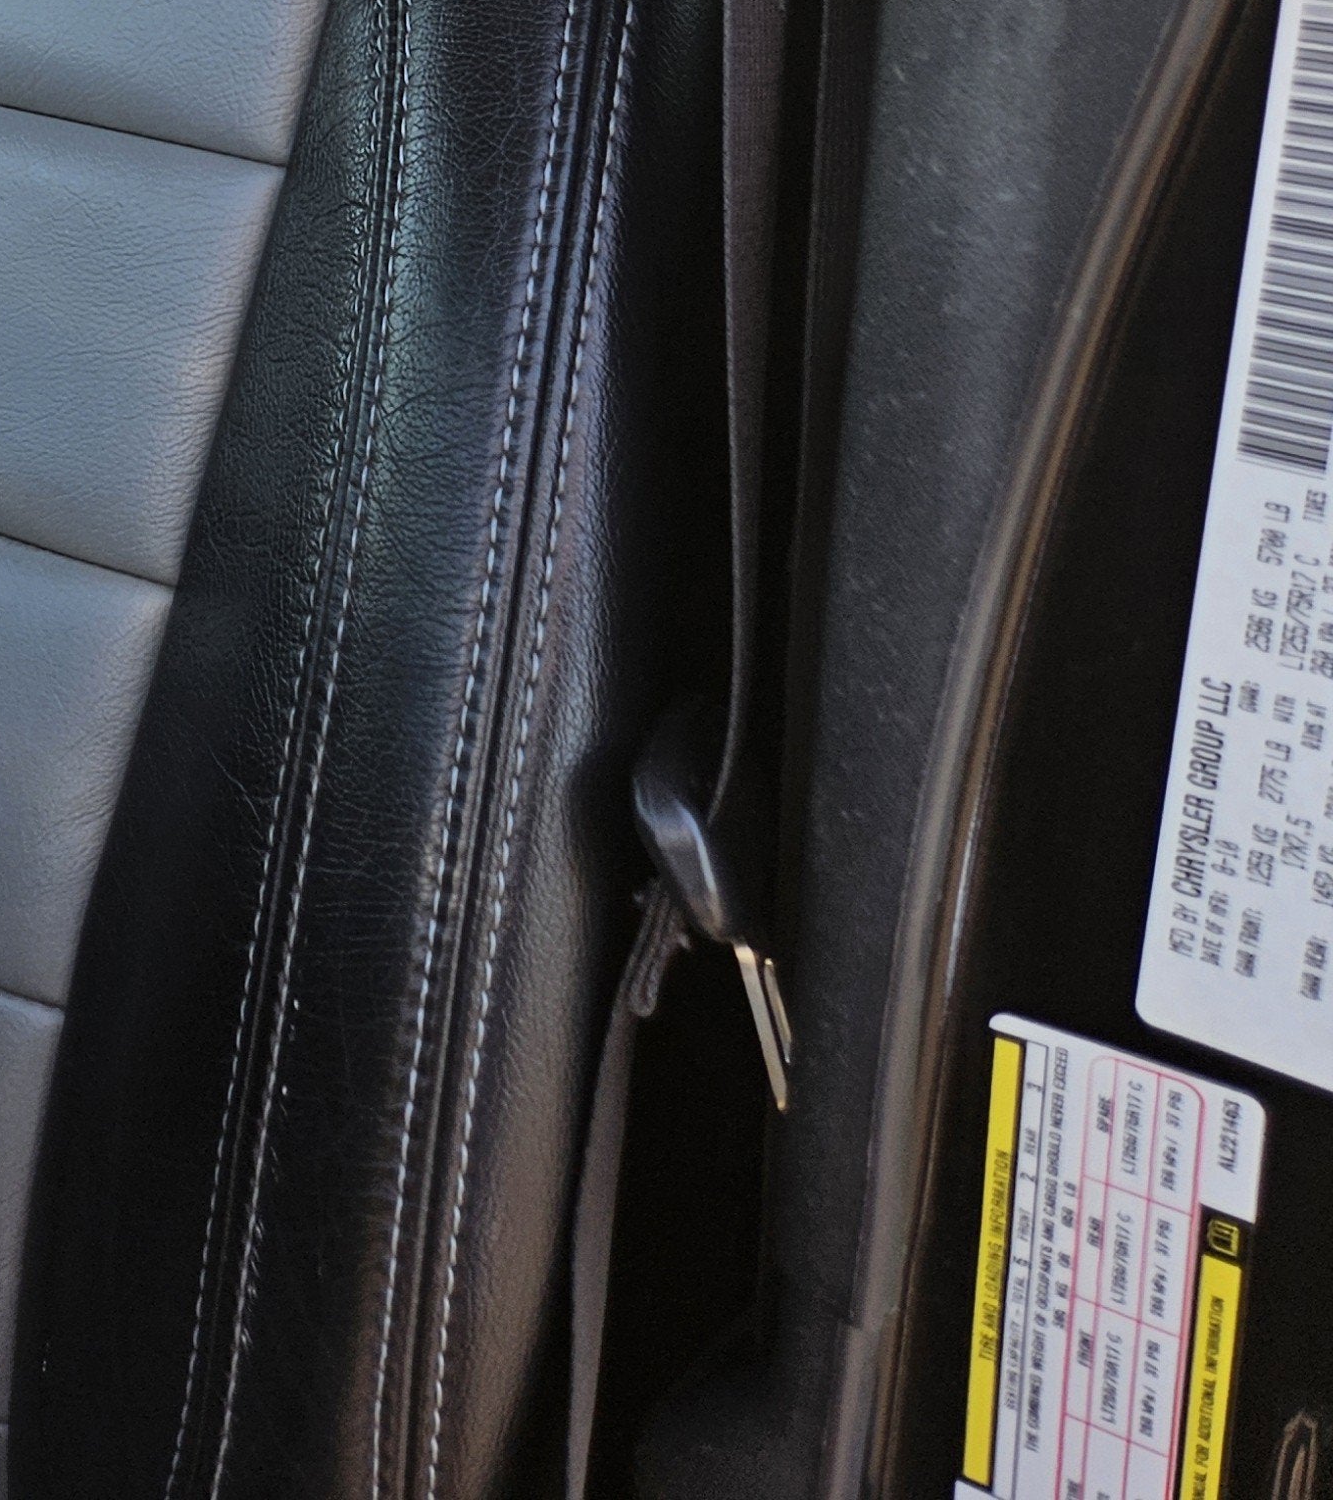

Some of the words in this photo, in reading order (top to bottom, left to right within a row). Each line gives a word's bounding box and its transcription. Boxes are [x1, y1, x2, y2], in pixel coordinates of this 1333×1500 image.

[1263, 502, 1291, 523] LB
[1257, 528, 1286, 566] 5700
[1252, 589, 1278, 609] KG
[1197, 677, 1231, 716] LLC
[1187, 719, 1225, 790] GROUP
[1264, 740, 1291, 762] LB
[1170, 794, 1214, 899] CHRYSLER
[1252, 824, 1278, 846] KG
[1172, 904, 1198, 925] BY
[1053, 1046, 1068, 1091] EXCEED
[1050, 1092, 1064, 1130] NEVER
[990, 1149, 1009, 1240] INFORMATION
[984, 1242, 1003, 1300] LOADING
[981, 1303, 998, 1331] AND
[1204, 1296, 1225, 1375] INFORMATION
[978, 1332, 995, 1360] TIRE
